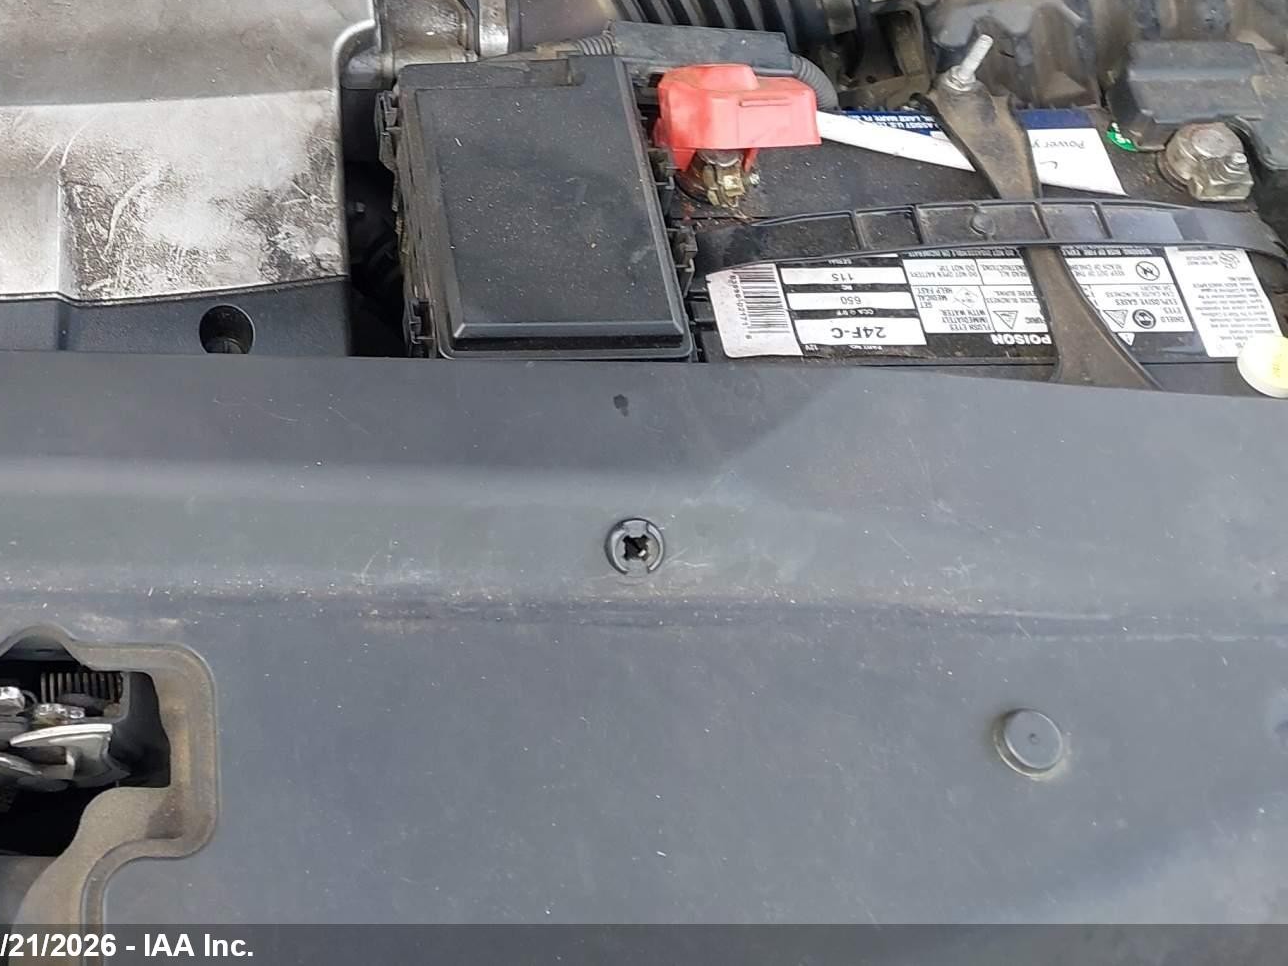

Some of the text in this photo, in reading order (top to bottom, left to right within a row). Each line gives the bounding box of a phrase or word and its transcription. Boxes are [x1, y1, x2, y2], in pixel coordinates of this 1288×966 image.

[1044, 140, 1086, 150] Power
[840, 296, 861, 305] 650
[830, 327, 887, 339] 24F-C
[990, 334, 1052, 345] POISON
